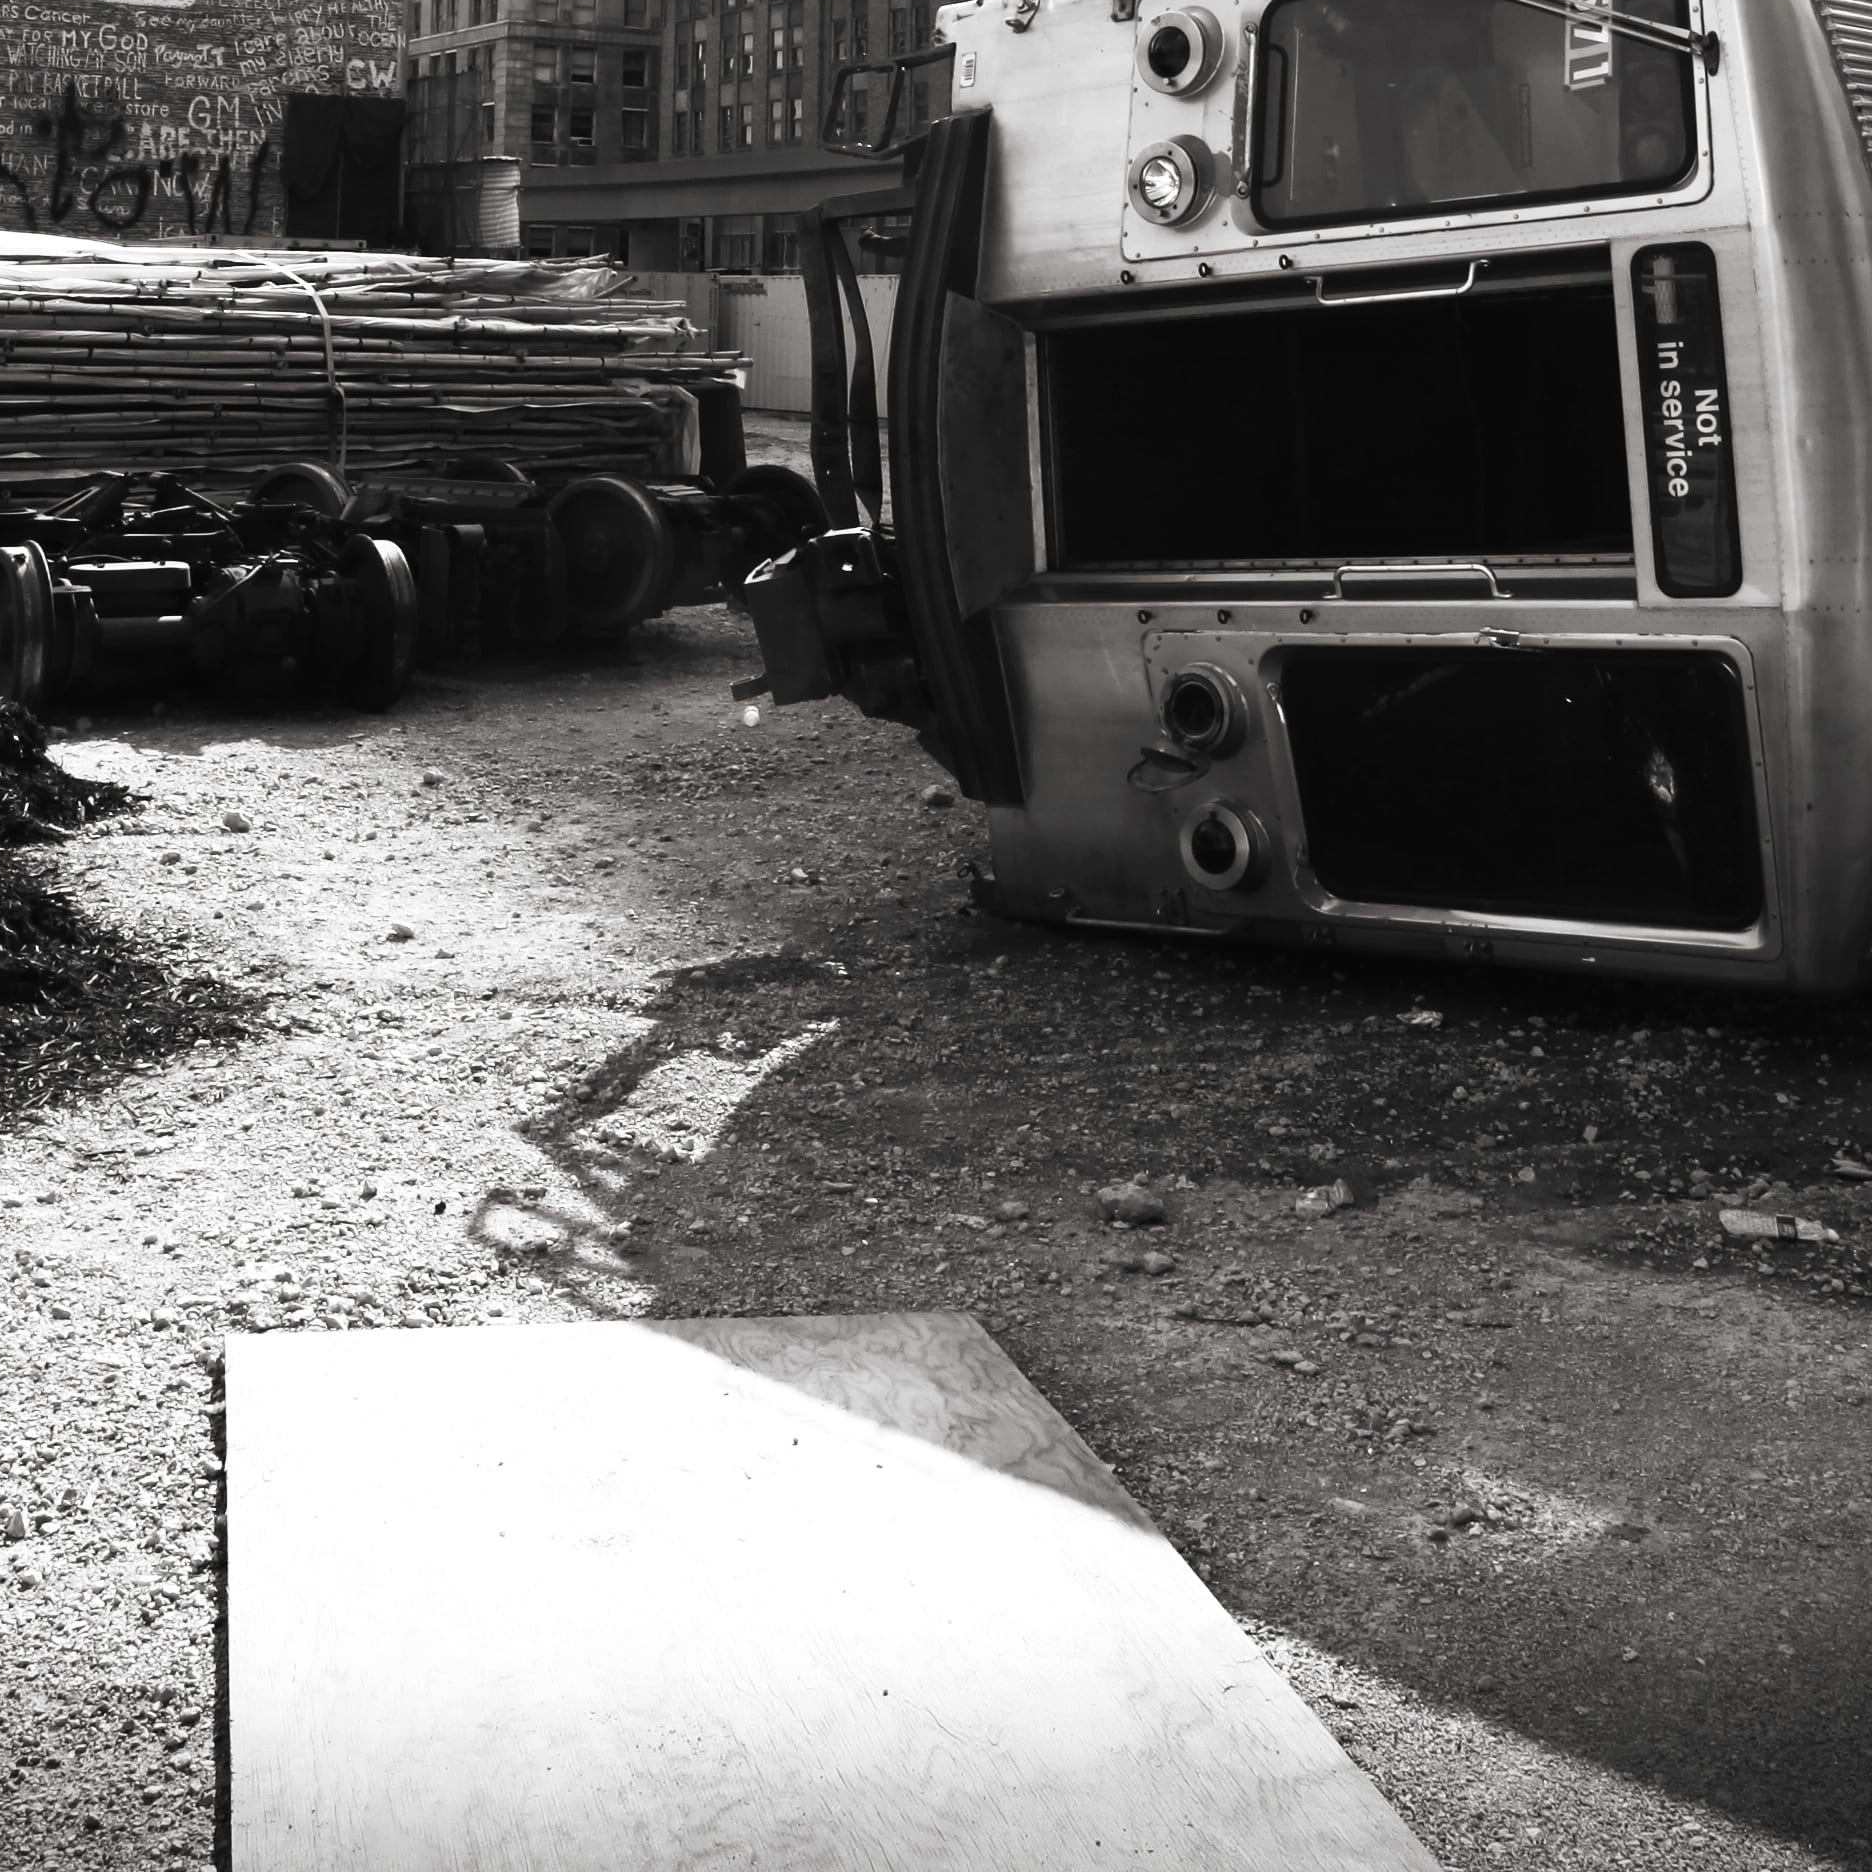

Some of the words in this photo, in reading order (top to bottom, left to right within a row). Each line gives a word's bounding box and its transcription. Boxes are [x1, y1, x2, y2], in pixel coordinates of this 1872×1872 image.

[23, 4, 91, 26] Cancer
[366, 14, 398, 32] THE
[22, 29, 53, 44] FOR
[62, 29, 93, 50] MY
[357, 30, 407, 50] OCEAN
[7, 42, 81, 69] WATCHING
[114, 49, 148, 74] SON
[239, 55, 267, 78] my
[274, 43, 345, 68] elderly
[164, 73, 241, 91] FORWARD
[125, 102, 170, 117] store
[188, 95, 240, 130] GM
[1656, 340, 1686, 370] in
[1693, 388, 1723, 448] Not
[1659, 378, 1694, 498] service
